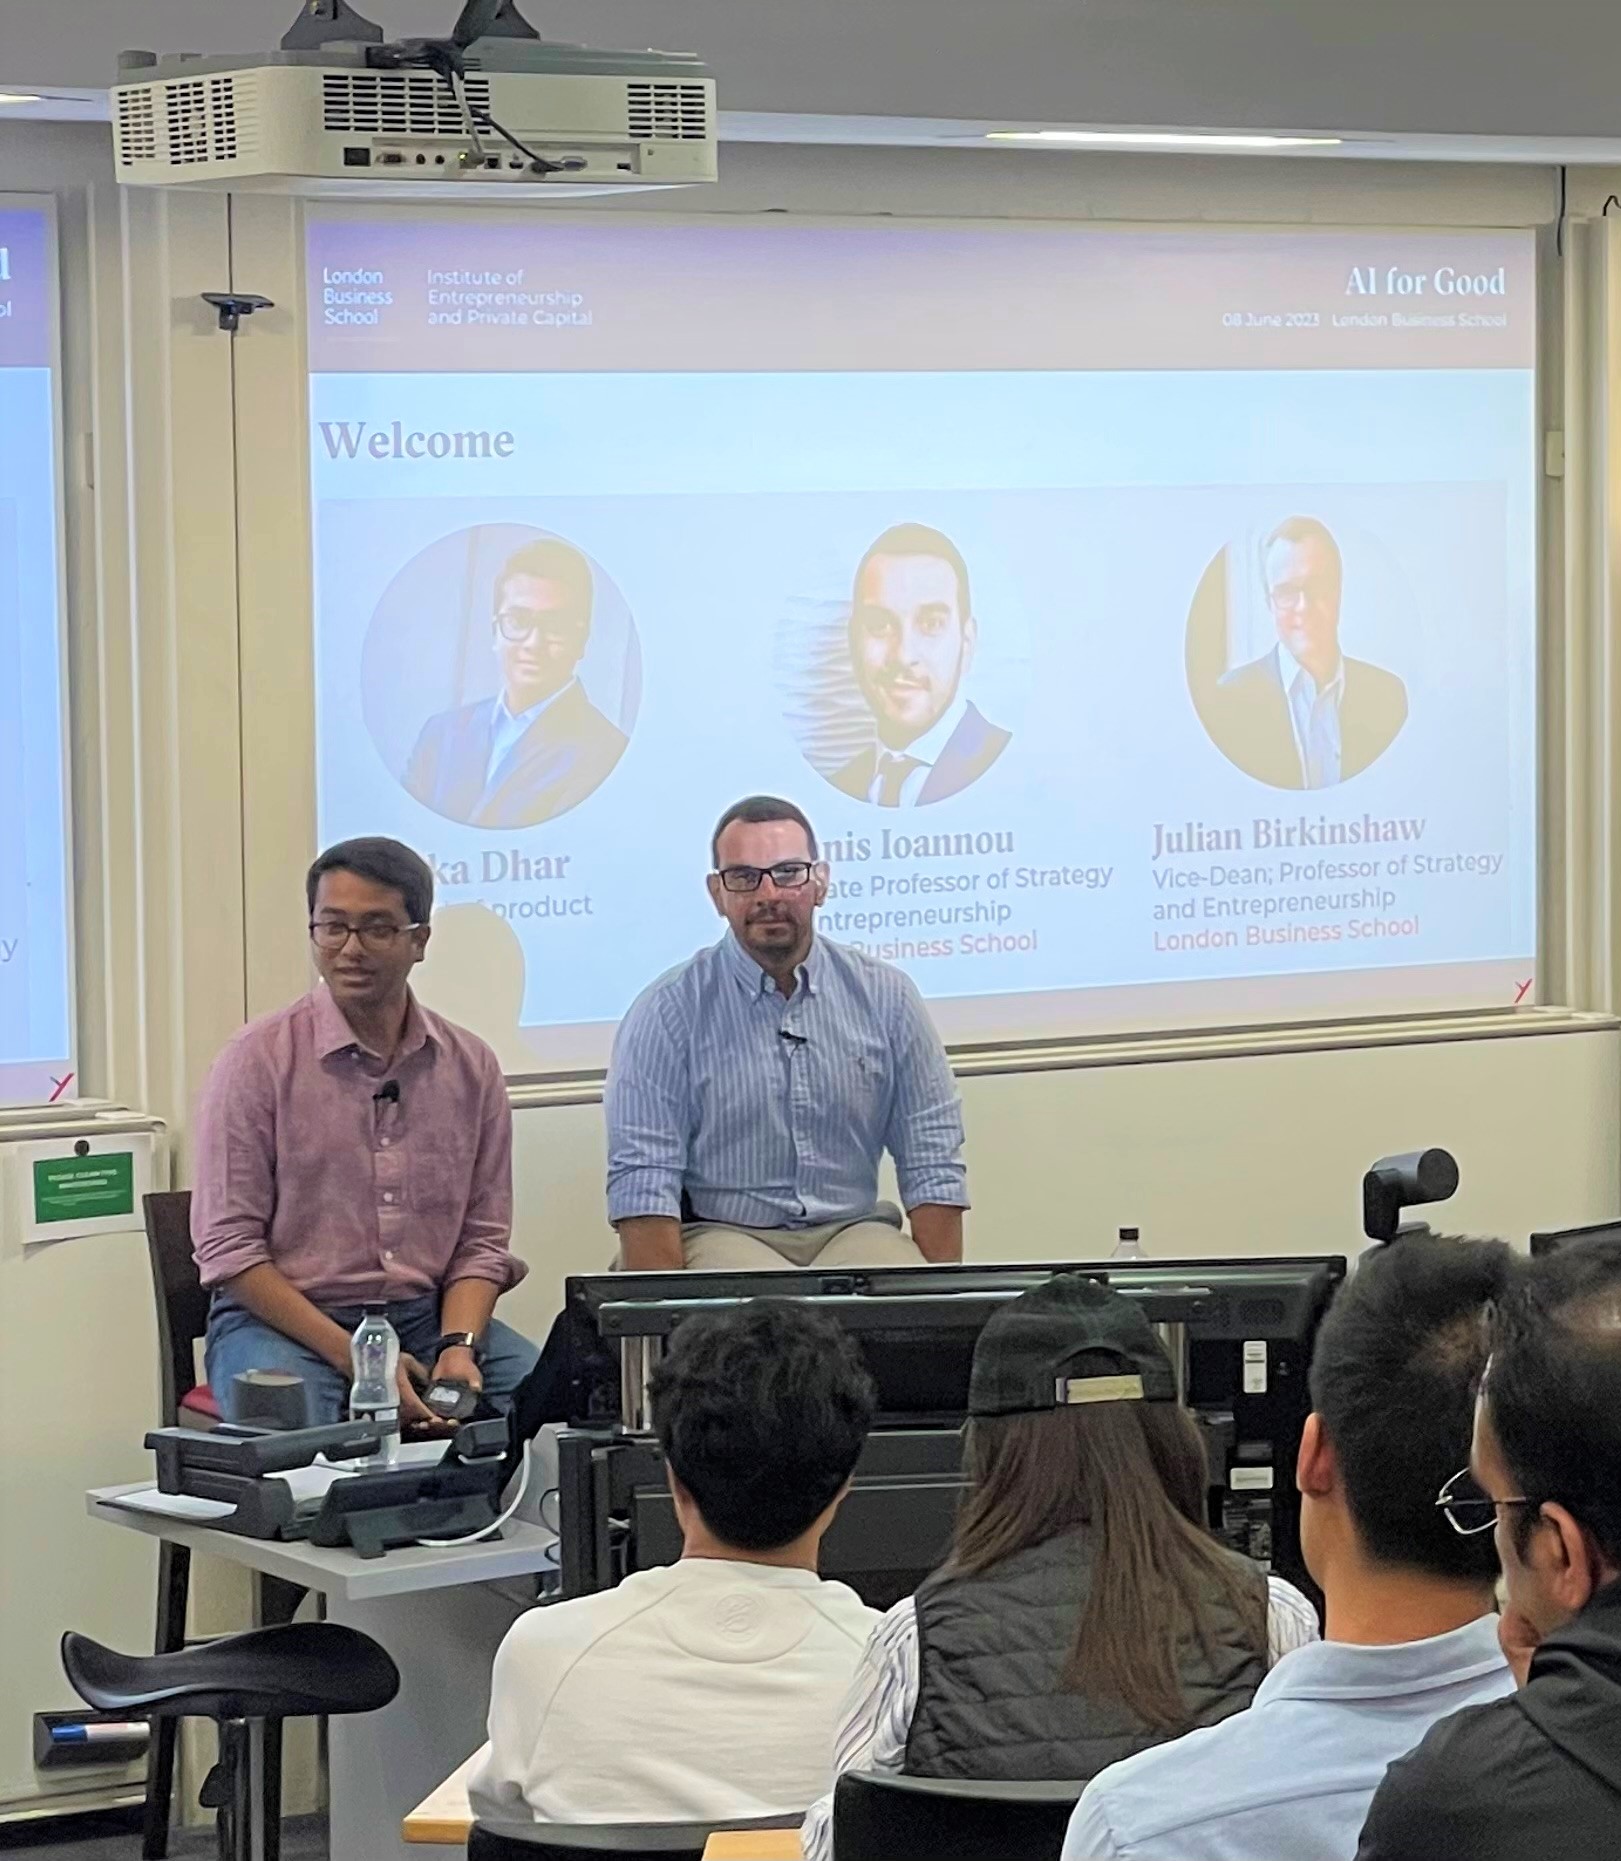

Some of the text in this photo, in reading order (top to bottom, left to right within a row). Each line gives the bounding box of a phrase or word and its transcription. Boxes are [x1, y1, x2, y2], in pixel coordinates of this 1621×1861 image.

[323, 267, 383, 285] London
[428, 269, 524, 285] Institute of
[1345, 266, 1506, 296] AI for Good
[323, 288, 393, 305] Business
[428, 290, 583, 308] Entrepreneurship
[324, 308, 379, 325] School
[428, 310, 593, 328] and Private Capital
[1245, 312, 1282, 328] June
[1284, 313, 1320, 327] 2023
[1332, 313, 1388, 327] London
[1391, 313, 1456, 327] Business
[1458, 312, 1507, 327] School
[318, 420, 515, 459] Welcome
[823, 829, 1015, 862] nis Ioannou
[1152, 813, 1425, 861] Julian Birkinshaw
[428, 849, 571, 886] ka Dhar
[870, 872, 980, 897] Professor
[986, 868, 1010, 890] of
[1015, 865, 1114, 889] Strategy
[1152, 851, 1503, 890] Vice-Dean; Professor of Strategy
[818, 900, 1012, 934] ntrepreneurship
[1153, 887, 1396, 921] and Entrepreneurship
[960, 930, 1038, 955] School
[1154, 915, 1420, 952] London Business School
